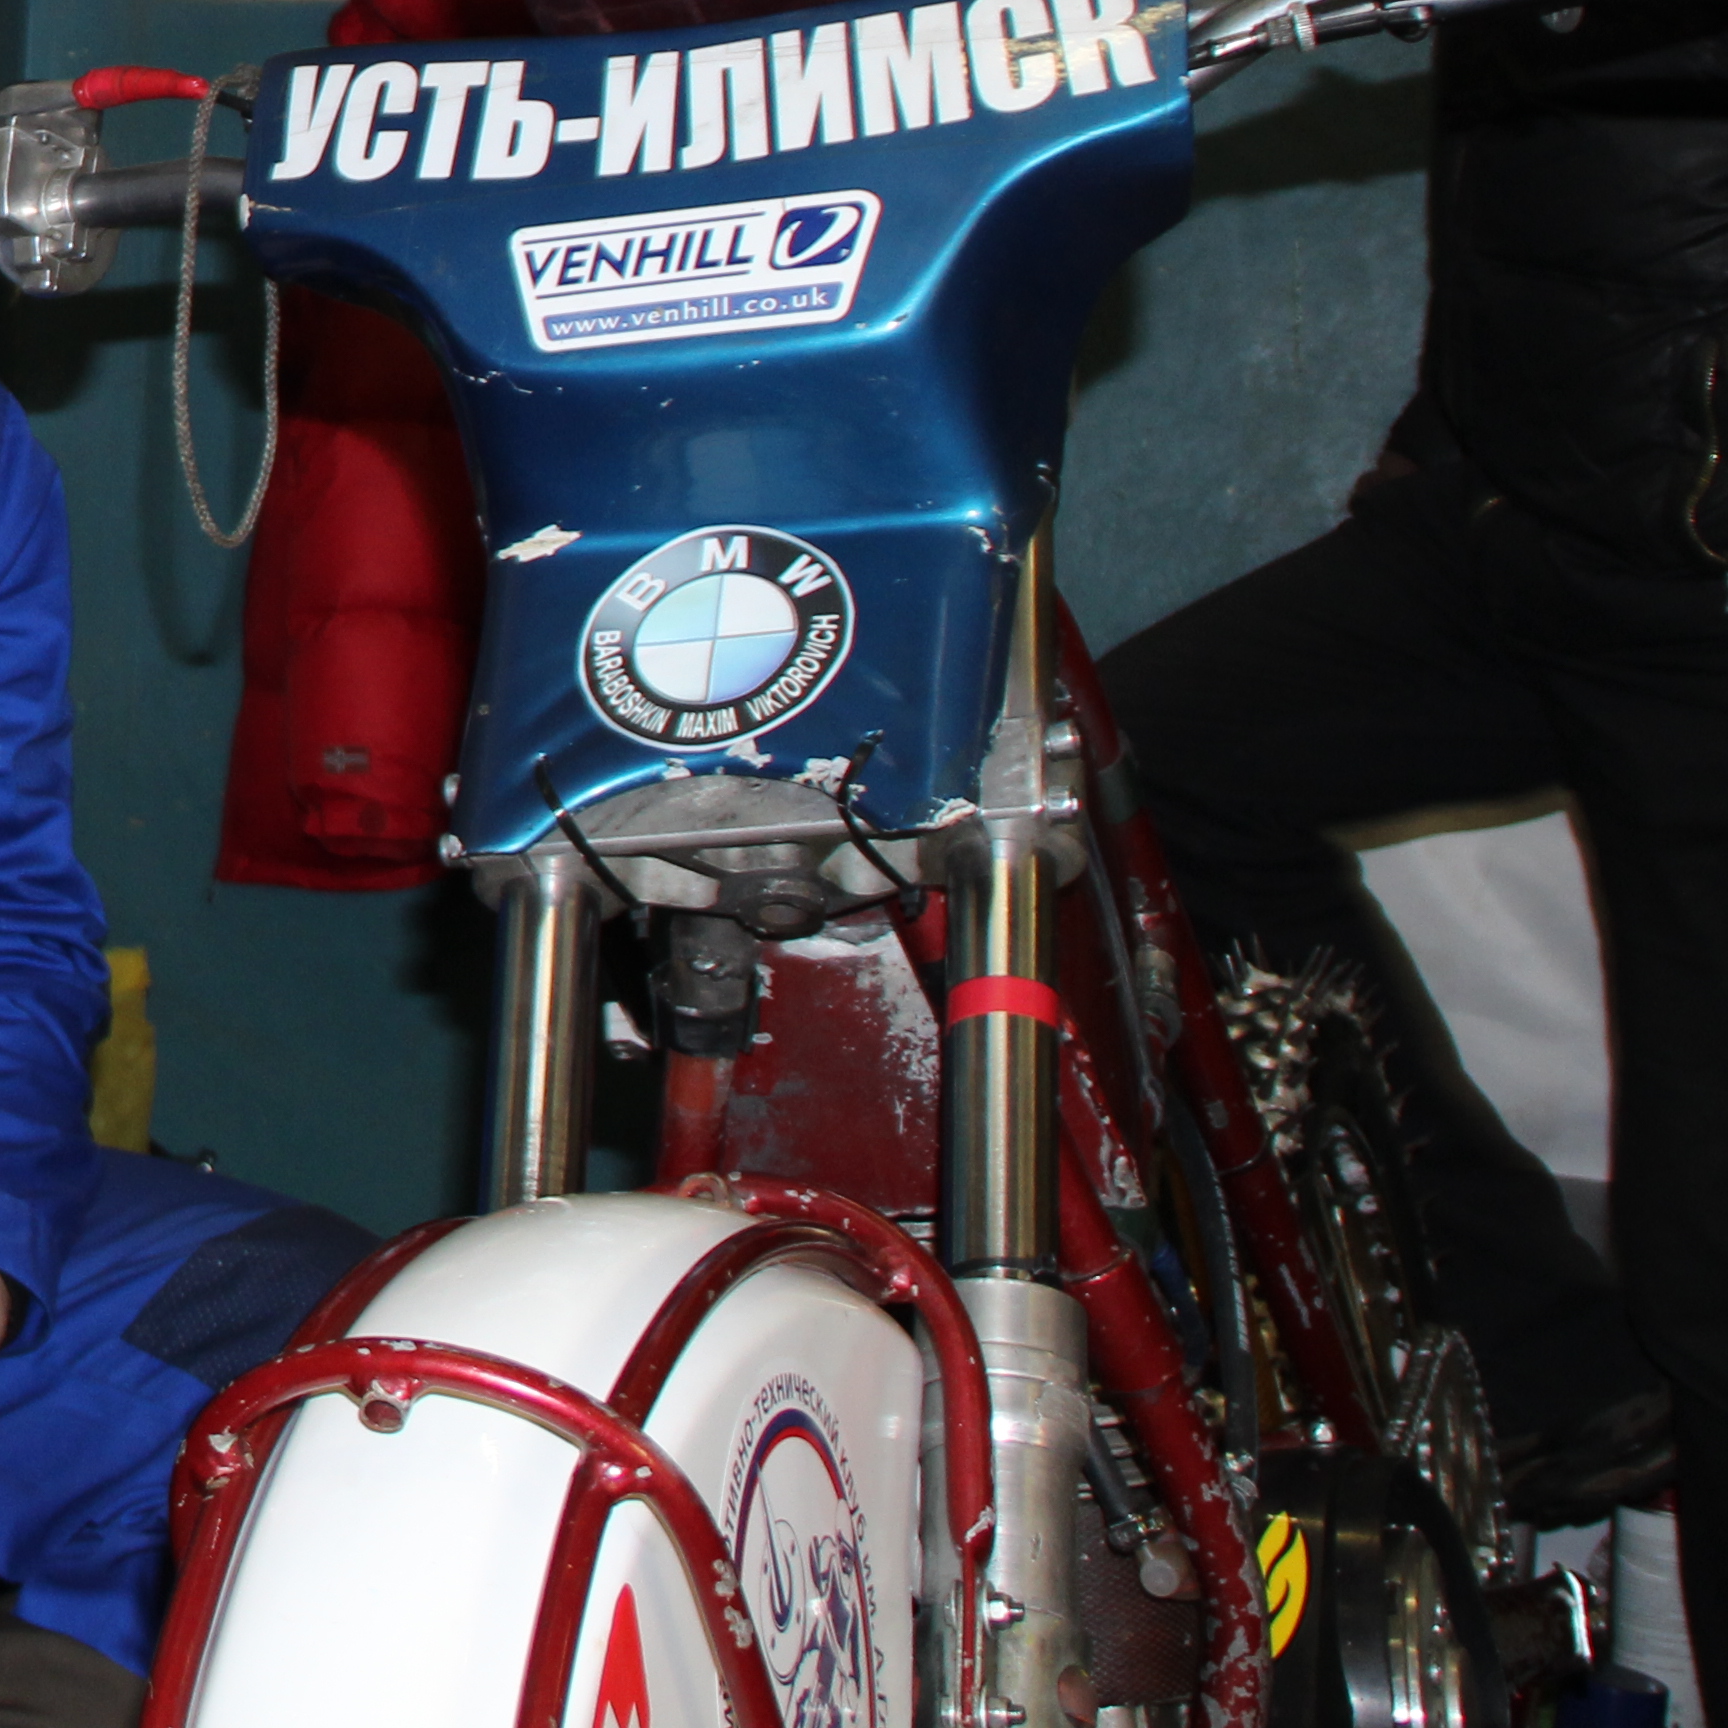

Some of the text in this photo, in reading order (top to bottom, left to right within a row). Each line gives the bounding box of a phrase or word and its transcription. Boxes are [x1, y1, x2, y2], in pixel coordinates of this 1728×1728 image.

[524, 213, 756, 292] VENHILL
[548, 286, 830, 340] www.venhill.co.uk
[617, 535, 834, 612] BMW
[593, 613, 840, 739] BARABOSHKIN MAXIM VIKTOROVICH
